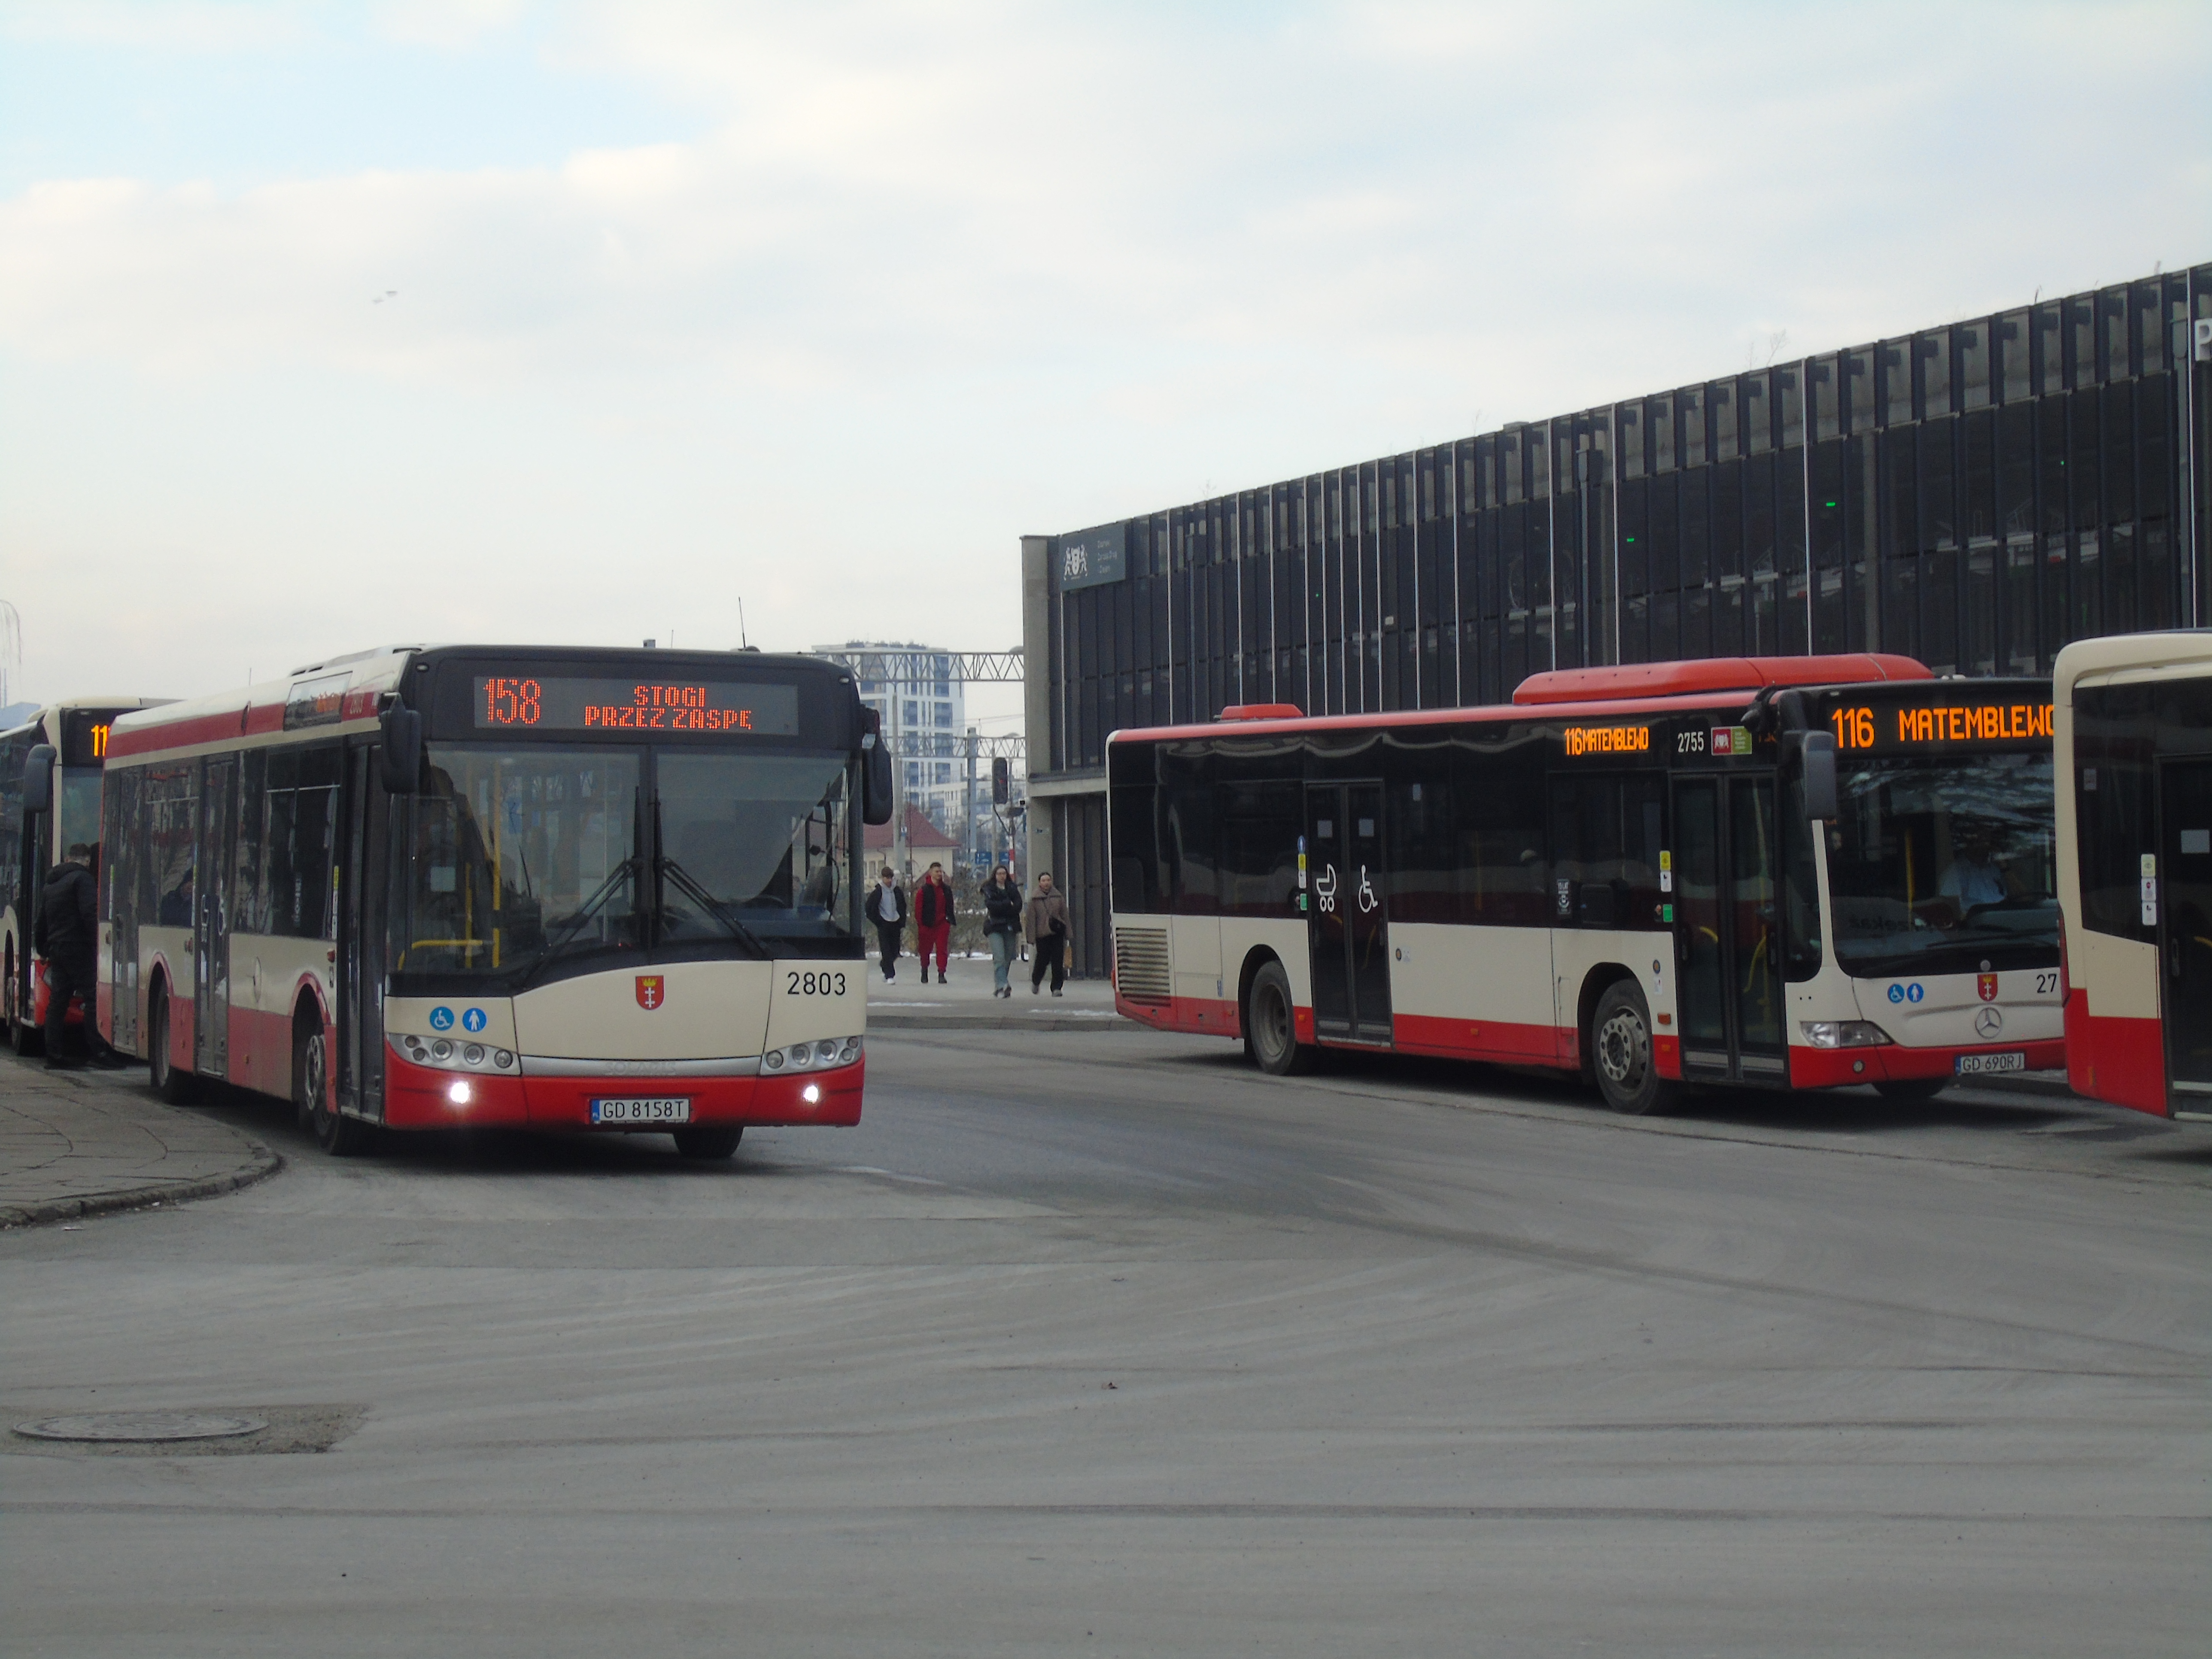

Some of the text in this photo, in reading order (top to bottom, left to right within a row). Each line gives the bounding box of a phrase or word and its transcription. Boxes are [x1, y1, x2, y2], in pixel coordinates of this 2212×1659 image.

[483, 678, 541, 724] 158
[634, 685, 705, 707] STOGI
[585, 706, 665, 728] PRZEZ
[1832, 707, 1875, 749] 116
[91, 724, 111, 757] 11
[1564, 726, 1649, 756] 116 MATEMBLEWO
[1677, 731, 1705, 753] 2755
[787, 972, 845, 995] 2803
[1963, 1054, 2021, 1071] GD 690RJ
[604, 1100, 684, 1118] GD 8158T
